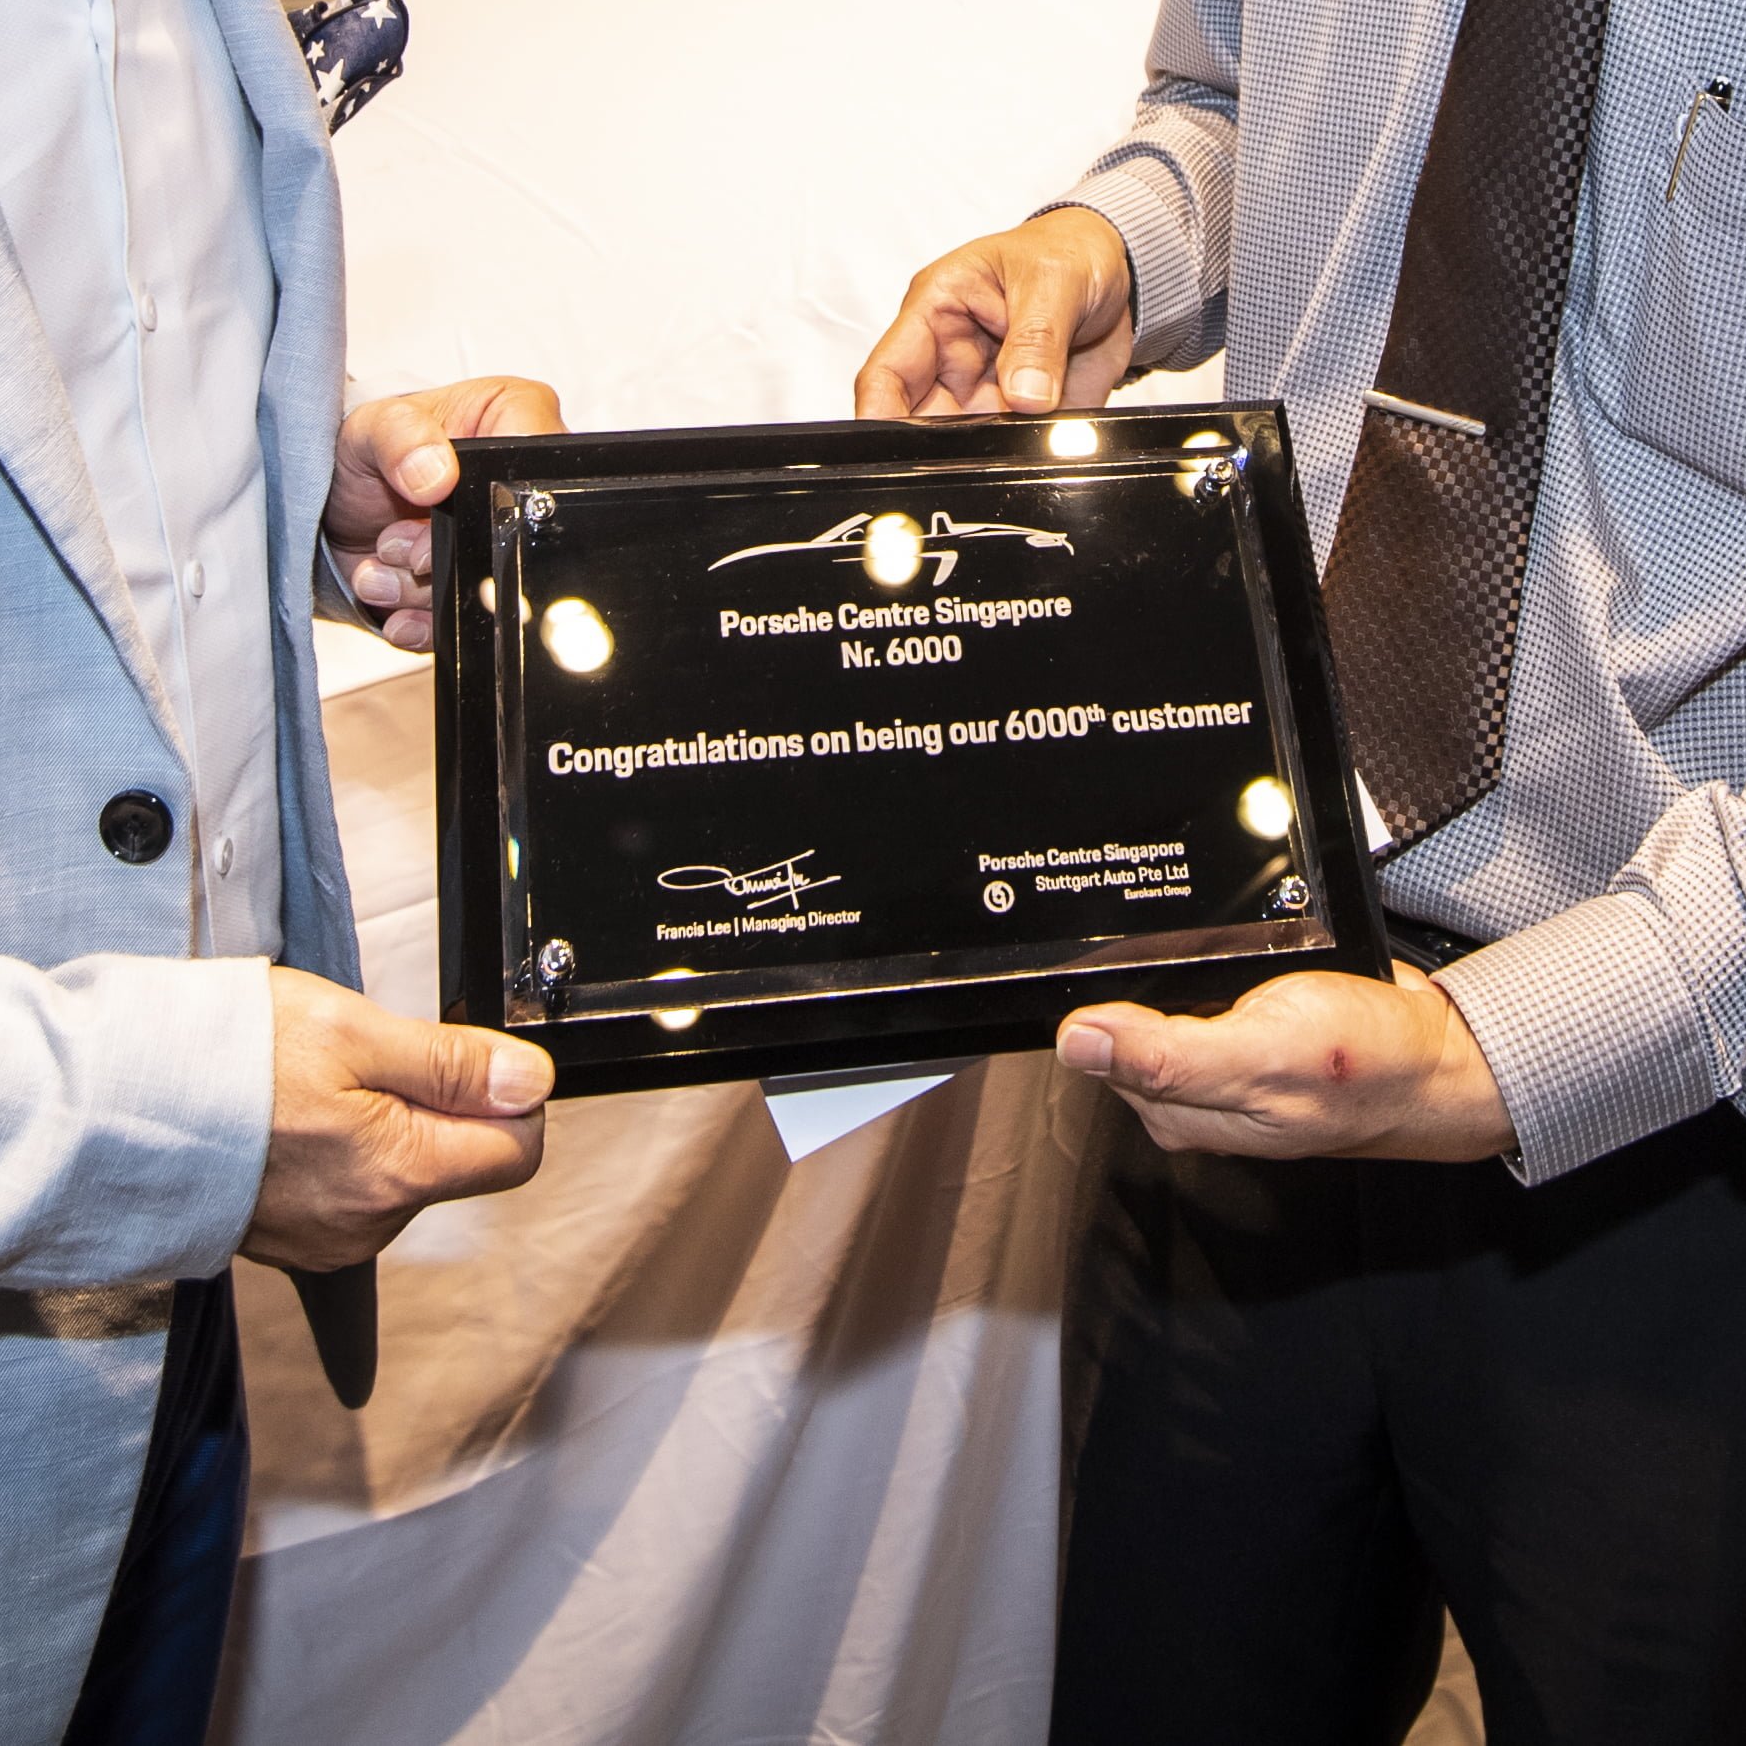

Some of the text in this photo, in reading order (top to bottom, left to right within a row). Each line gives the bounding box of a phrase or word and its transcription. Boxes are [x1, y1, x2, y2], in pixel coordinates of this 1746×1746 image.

[720, 597, 1072, 638] Porsche Centre Singapore
[841, 635, 962, 668] Nr. 6000
[548, 729, 804, 778] Congratulations
[810, 730, 850, 756] on
[856, 719, 943, 755] being
[949, 720, 999, 745] our
[1112, 702, 1252, 733] customer
[978, 842, 1185, 872] Porsche Centre Singapore
[1035, 863, 1189, 892] Stuttgart Auto Pte Ltd
[1123, 884, 1192, 900] Eurokars Group
[657, 921, 704, 940] Francis
[707, 919, 731, 936] Lee
[742, 913, 806, 933] Managing
[808, 910, 862, 927] Director
